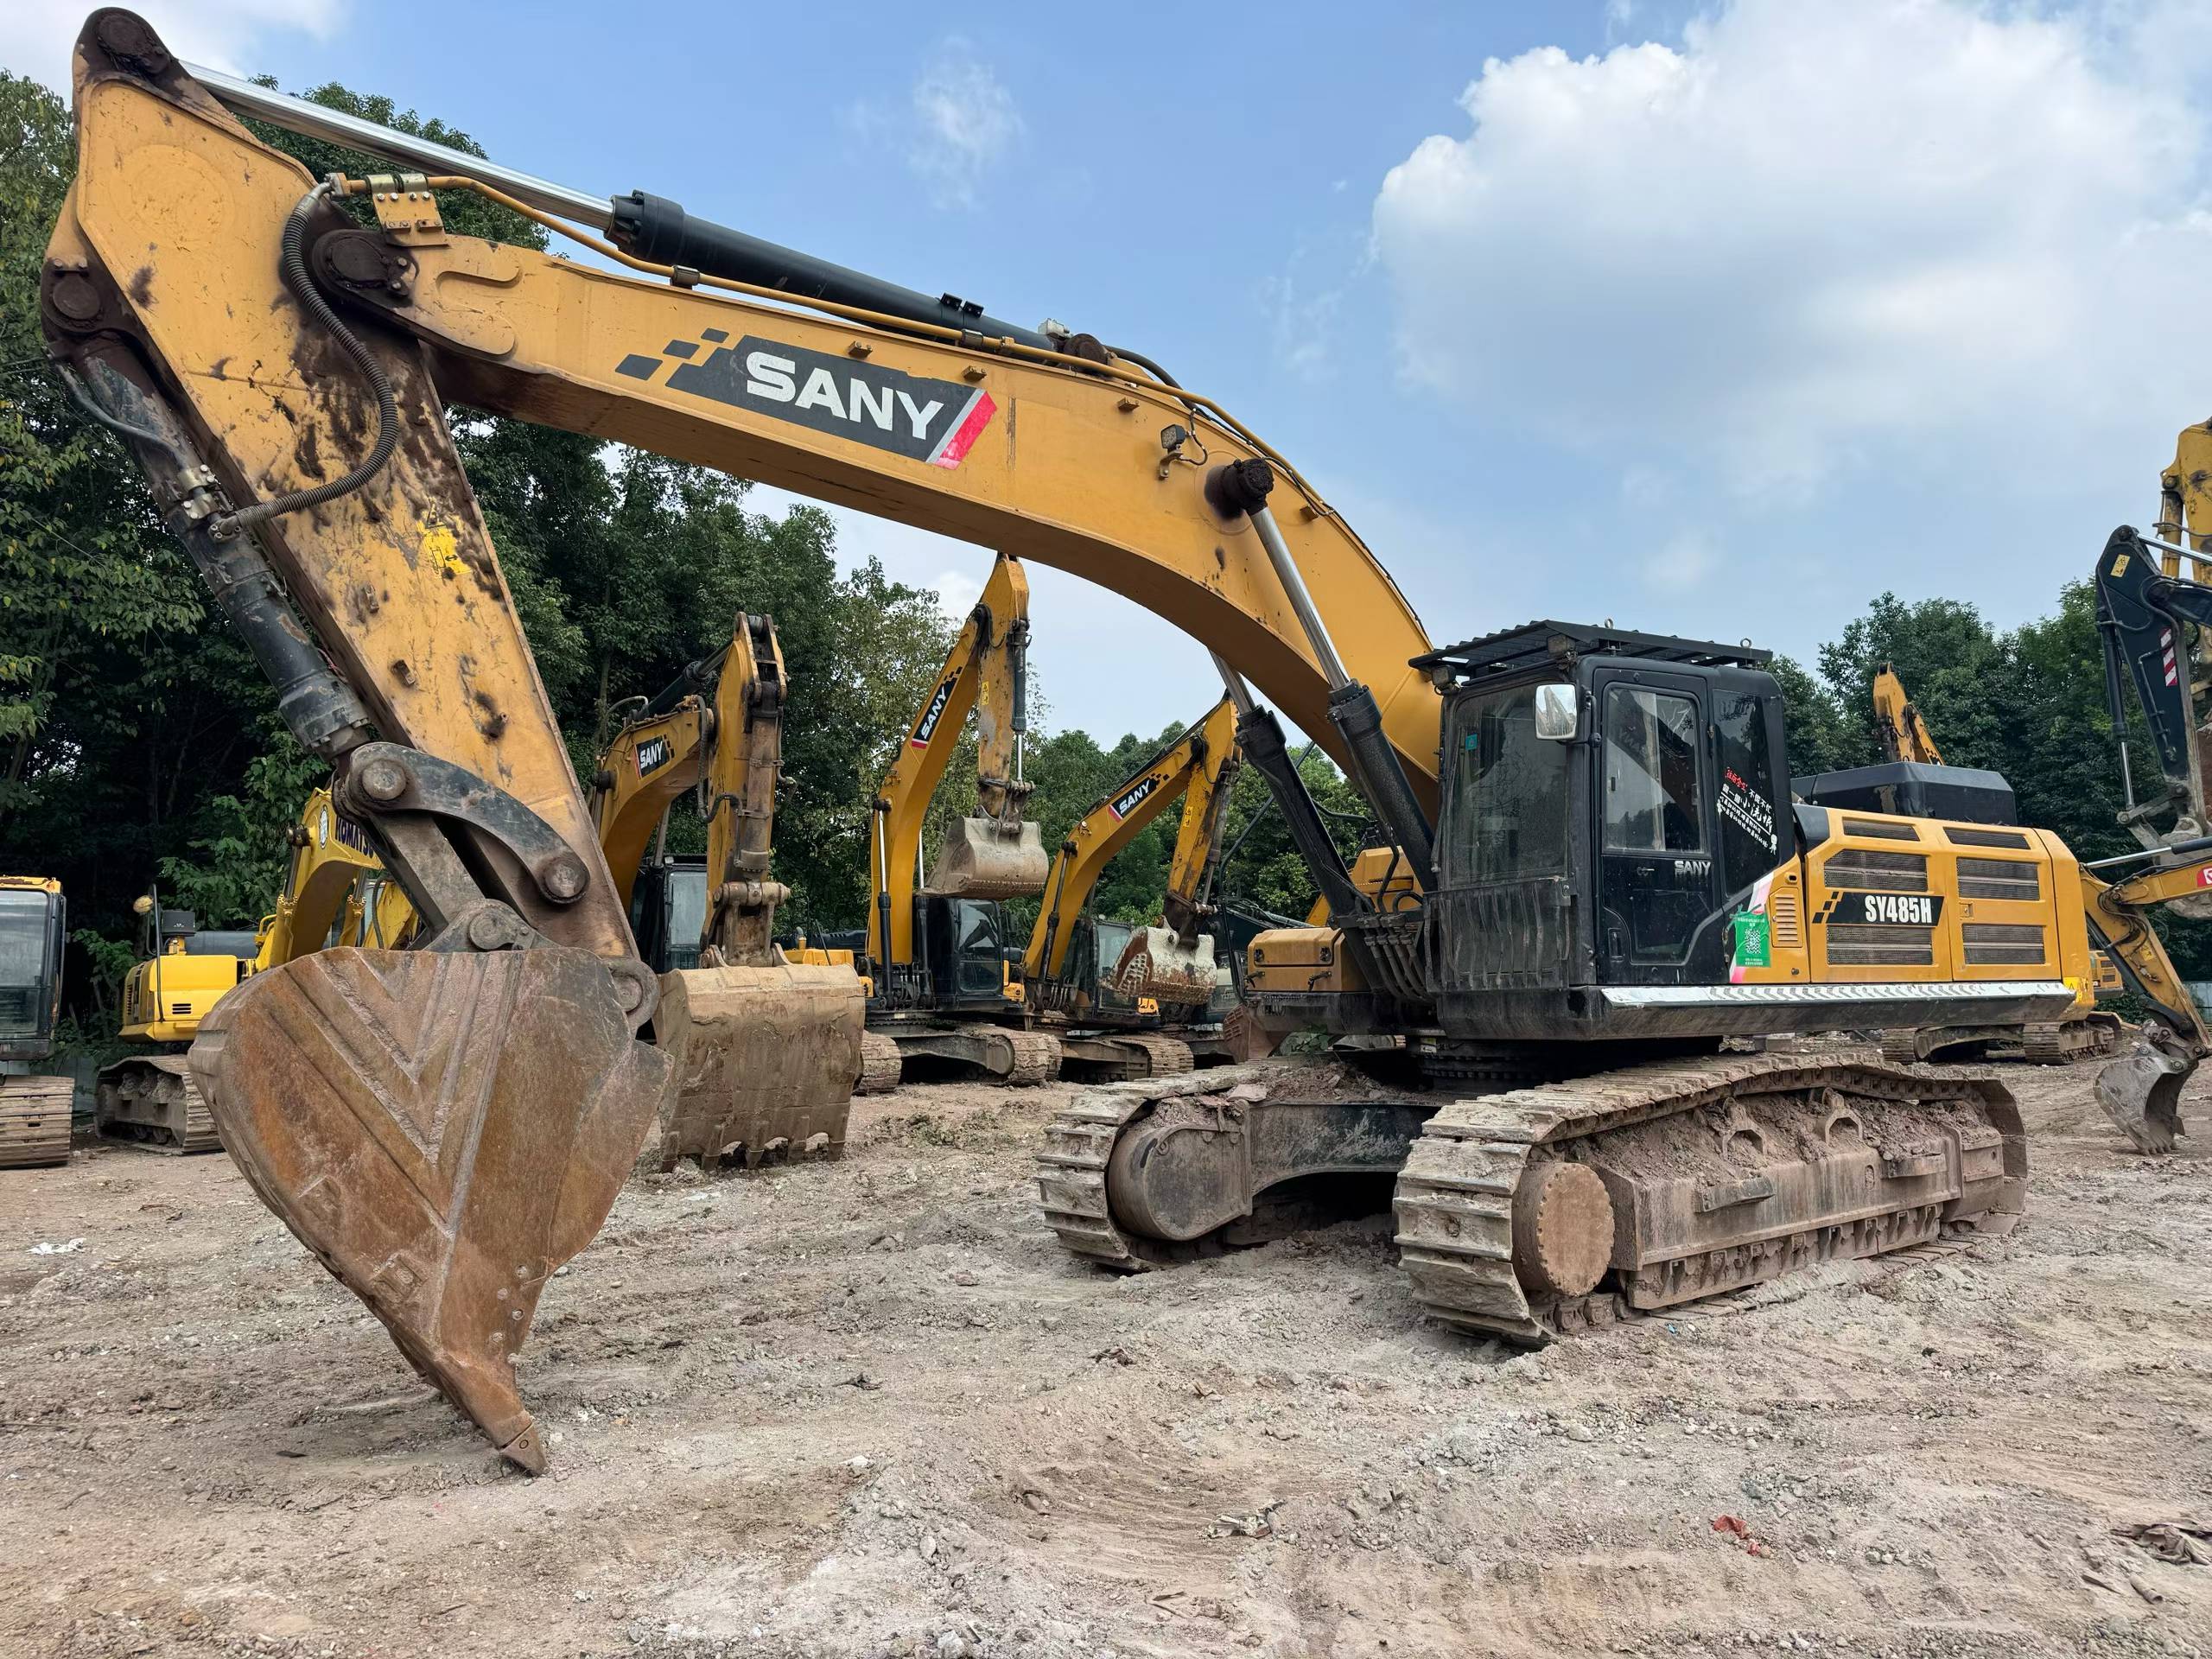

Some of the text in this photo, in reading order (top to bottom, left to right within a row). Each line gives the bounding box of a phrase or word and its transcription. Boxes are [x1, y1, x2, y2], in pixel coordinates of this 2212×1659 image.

[746, 351, 944, 440] SANY
[921, 686, 946, 740] SANY
[640, 741, 663, 769] SANY
[1119, 779, 1150, 815] SANY
[1674, 860, 1711, 876] SANY
[1865, 894, 1932, 924] SY485H
